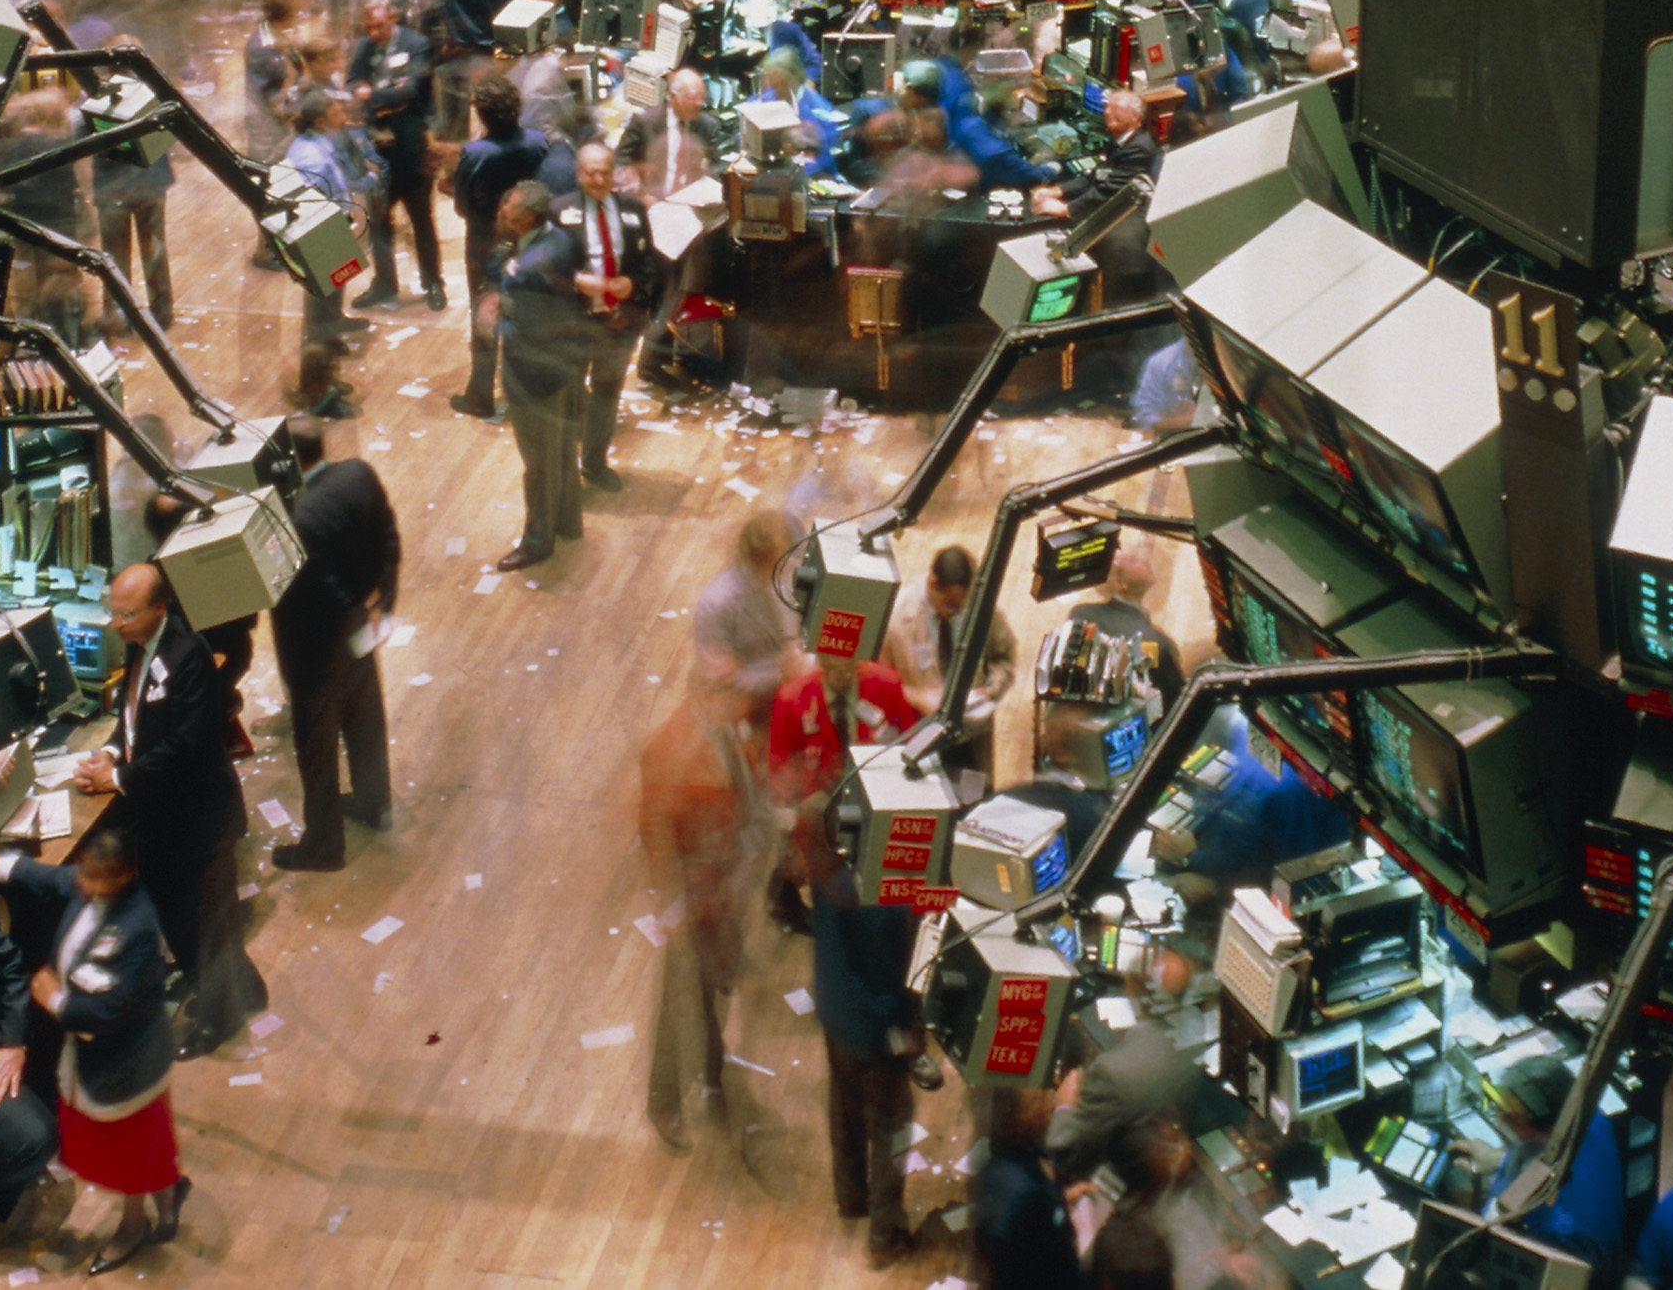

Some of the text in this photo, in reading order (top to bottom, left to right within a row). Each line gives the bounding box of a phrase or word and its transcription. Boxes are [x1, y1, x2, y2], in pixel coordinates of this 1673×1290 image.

[1029, 4, 1055, 18] 2261
[1496, 292, 1566, 378] 11
[825, 612, 851, 628] DOV
[820, 634, 844, 651] BAX
[892, 820, 921, 835] ASN
[885, 847, 915, 863] HPC
[879, 881, 910, 897] ENS
[1000, 981, 1032, 1000] MYG
[998, 1017, 1029, 1032] SPP
[991, 1045, 1018, 1064] TEK
